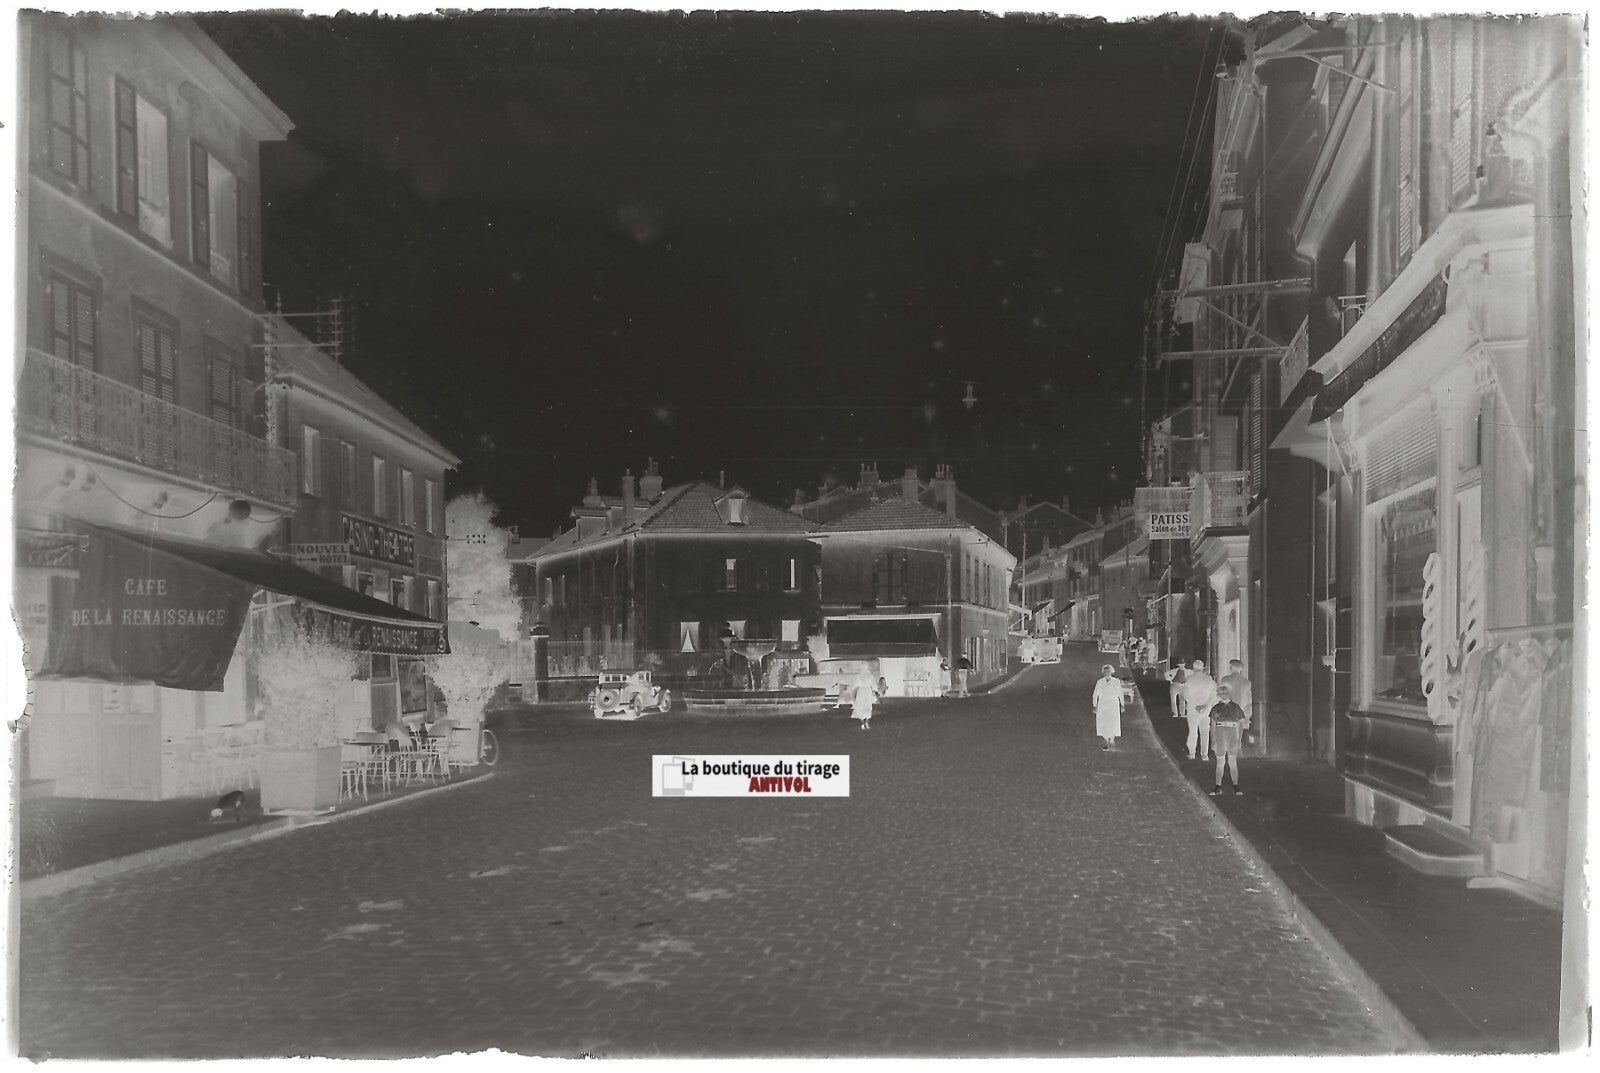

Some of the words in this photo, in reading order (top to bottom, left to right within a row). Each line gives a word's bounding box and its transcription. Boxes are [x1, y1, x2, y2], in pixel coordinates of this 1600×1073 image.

[1151, 514, 1189, 525] PATISS
[297, 544, 350, 554] NOUVEL
[125, 578, 168, 596] CAFE
[72, 609, 90, 626] DE
[94, 608, 112, 625] LA
[122, 609, 226, 626] RENAISSANCE
